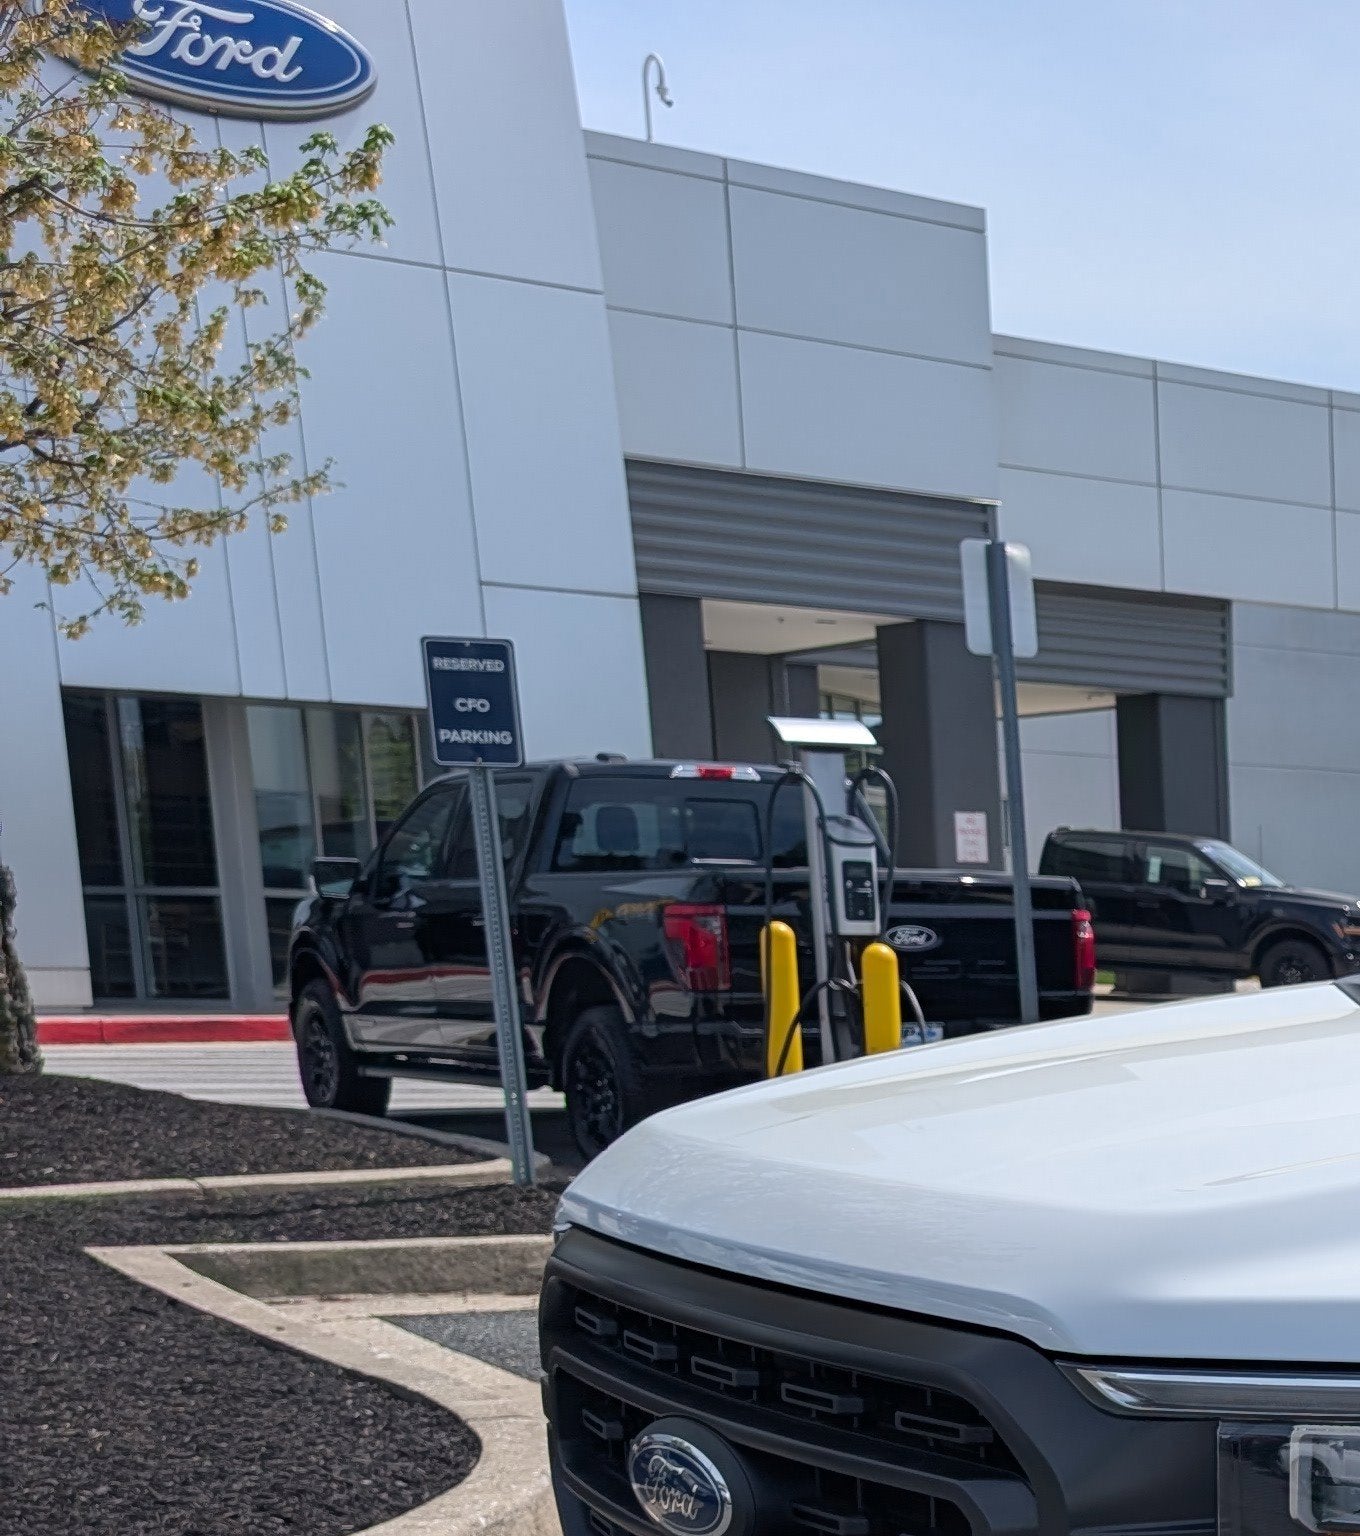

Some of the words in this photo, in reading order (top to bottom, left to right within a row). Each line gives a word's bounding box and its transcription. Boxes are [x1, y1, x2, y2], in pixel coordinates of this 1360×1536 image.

[125, 0, 304, 83] Ford
[432, 656, 505, 673] RESERVED
[439, 728, 513, 745] PARKING
[893, 928, 927, 945] Ford
[647, 1455, 699, 1520] Ford
